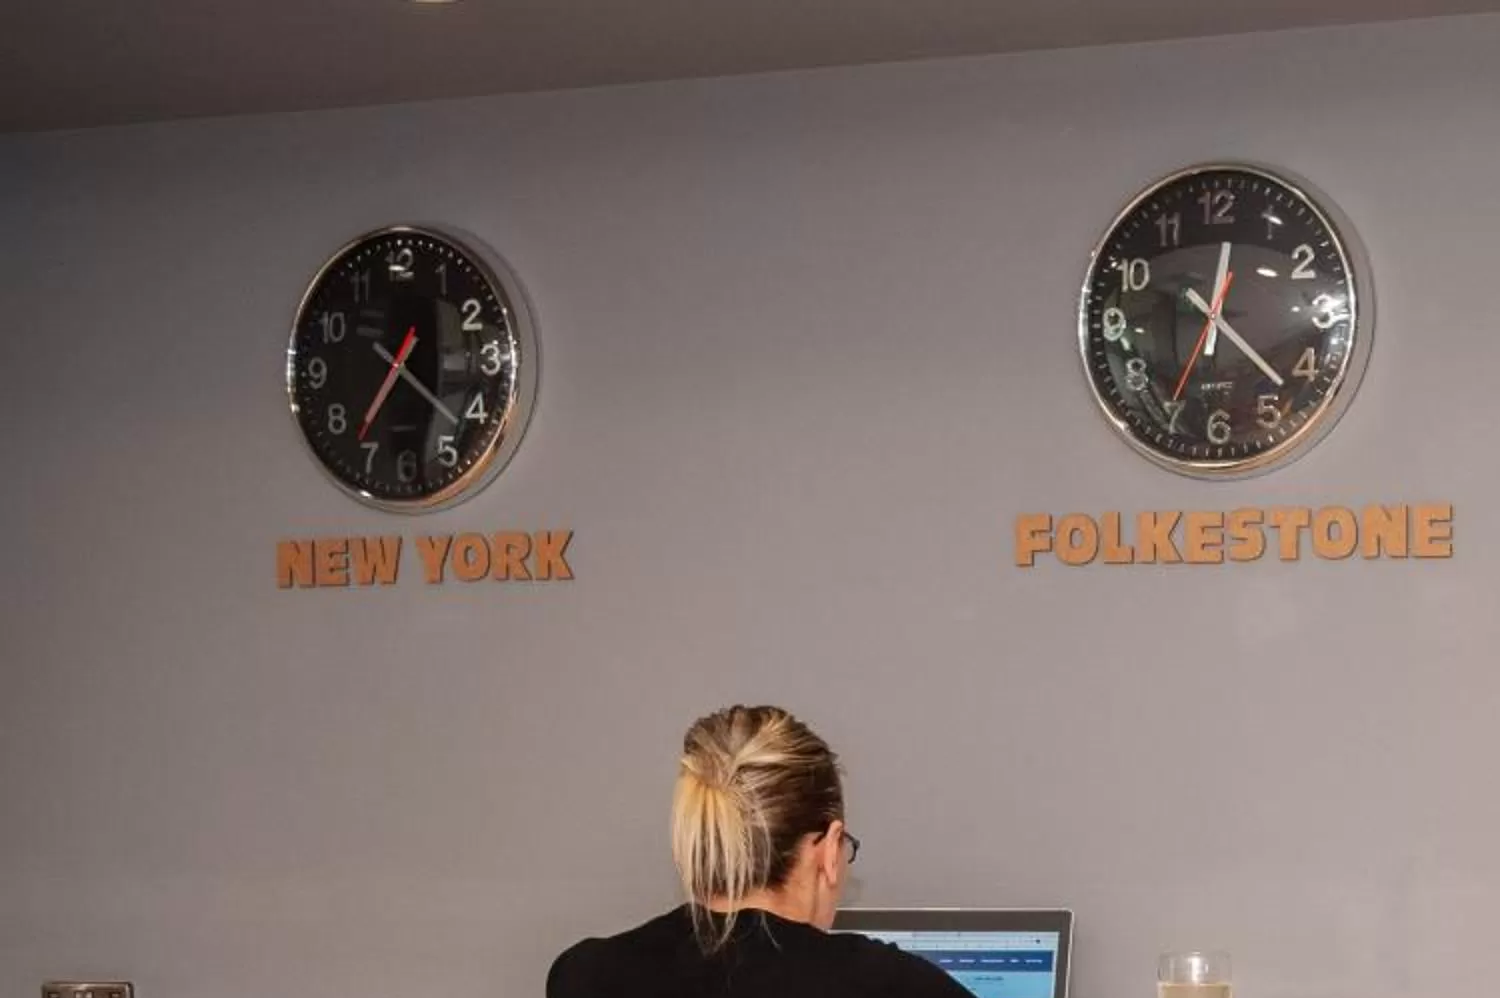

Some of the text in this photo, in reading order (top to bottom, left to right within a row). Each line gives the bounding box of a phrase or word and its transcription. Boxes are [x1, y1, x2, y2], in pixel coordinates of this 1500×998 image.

[1198, 189, 1236, 225] 12
[1261, 204, 1275, 240] 1
[1155, 212, 1182, 247] 11
[385, 248, 415, 281] 12
[1117, 257, 1150, 292] 10
[1291, 243, 1316, 280] 2
[350, 269, 371, 303] 11
[434, 262, 448, 296] 1
[319, 311, 346, 343] 10
[461, 299, 483, 331] 2
[1102, 307, 1126, 340] 9
[1312, 293, 1337, 329] 3
[308, 357, 328, 389] 9
[480, 344, 501, 376] 3
[1125, 357, 1149, 392] 8
[1291, 348, 1319, 382] 4
[328, 403, 347, 434] 8
[464, 392, 488, 424] 4
[1163, 400, 1184, 434] 7
[1256, 394, 1282, 429] 5
[1206, 410, 1232, 445] 6
[359, 441, 380, 474] 7
[397, 451, 418, 482] 6
[436, 436, 458, 466] 5
[1014, 503, 1455, 566] FOLKESTONE
[276, 528, 575, 589] NEW YORK
